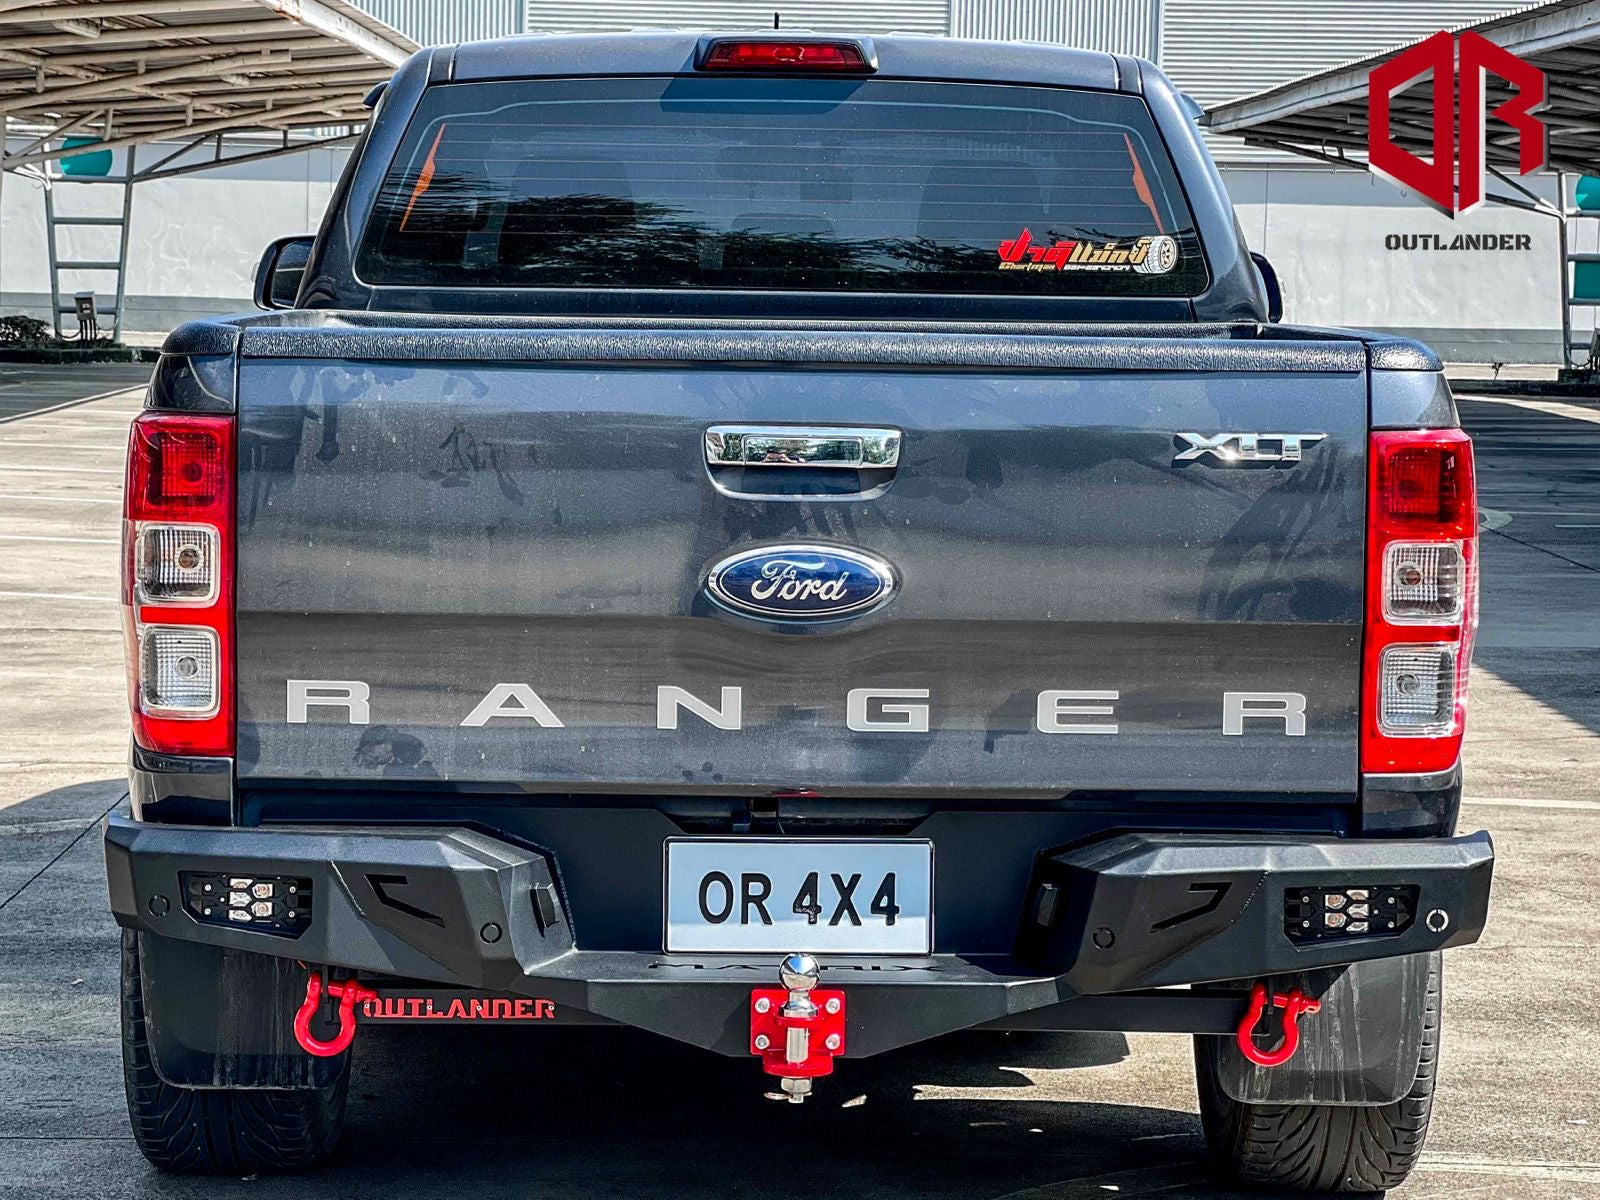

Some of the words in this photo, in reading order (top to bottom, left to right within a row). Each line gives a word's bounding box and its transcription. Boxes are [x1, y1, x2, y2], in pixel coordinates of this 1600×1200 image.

[1174, 432, 1328, 462] XLT
[751, 560, 848, 601] Ford
[286, 679, 1307, 736] RANGER
[698, 871, 773, 925] OR
[792, 871, 900, 926] 4X4
[362, 997, 556, 1020] OUTLANDER
